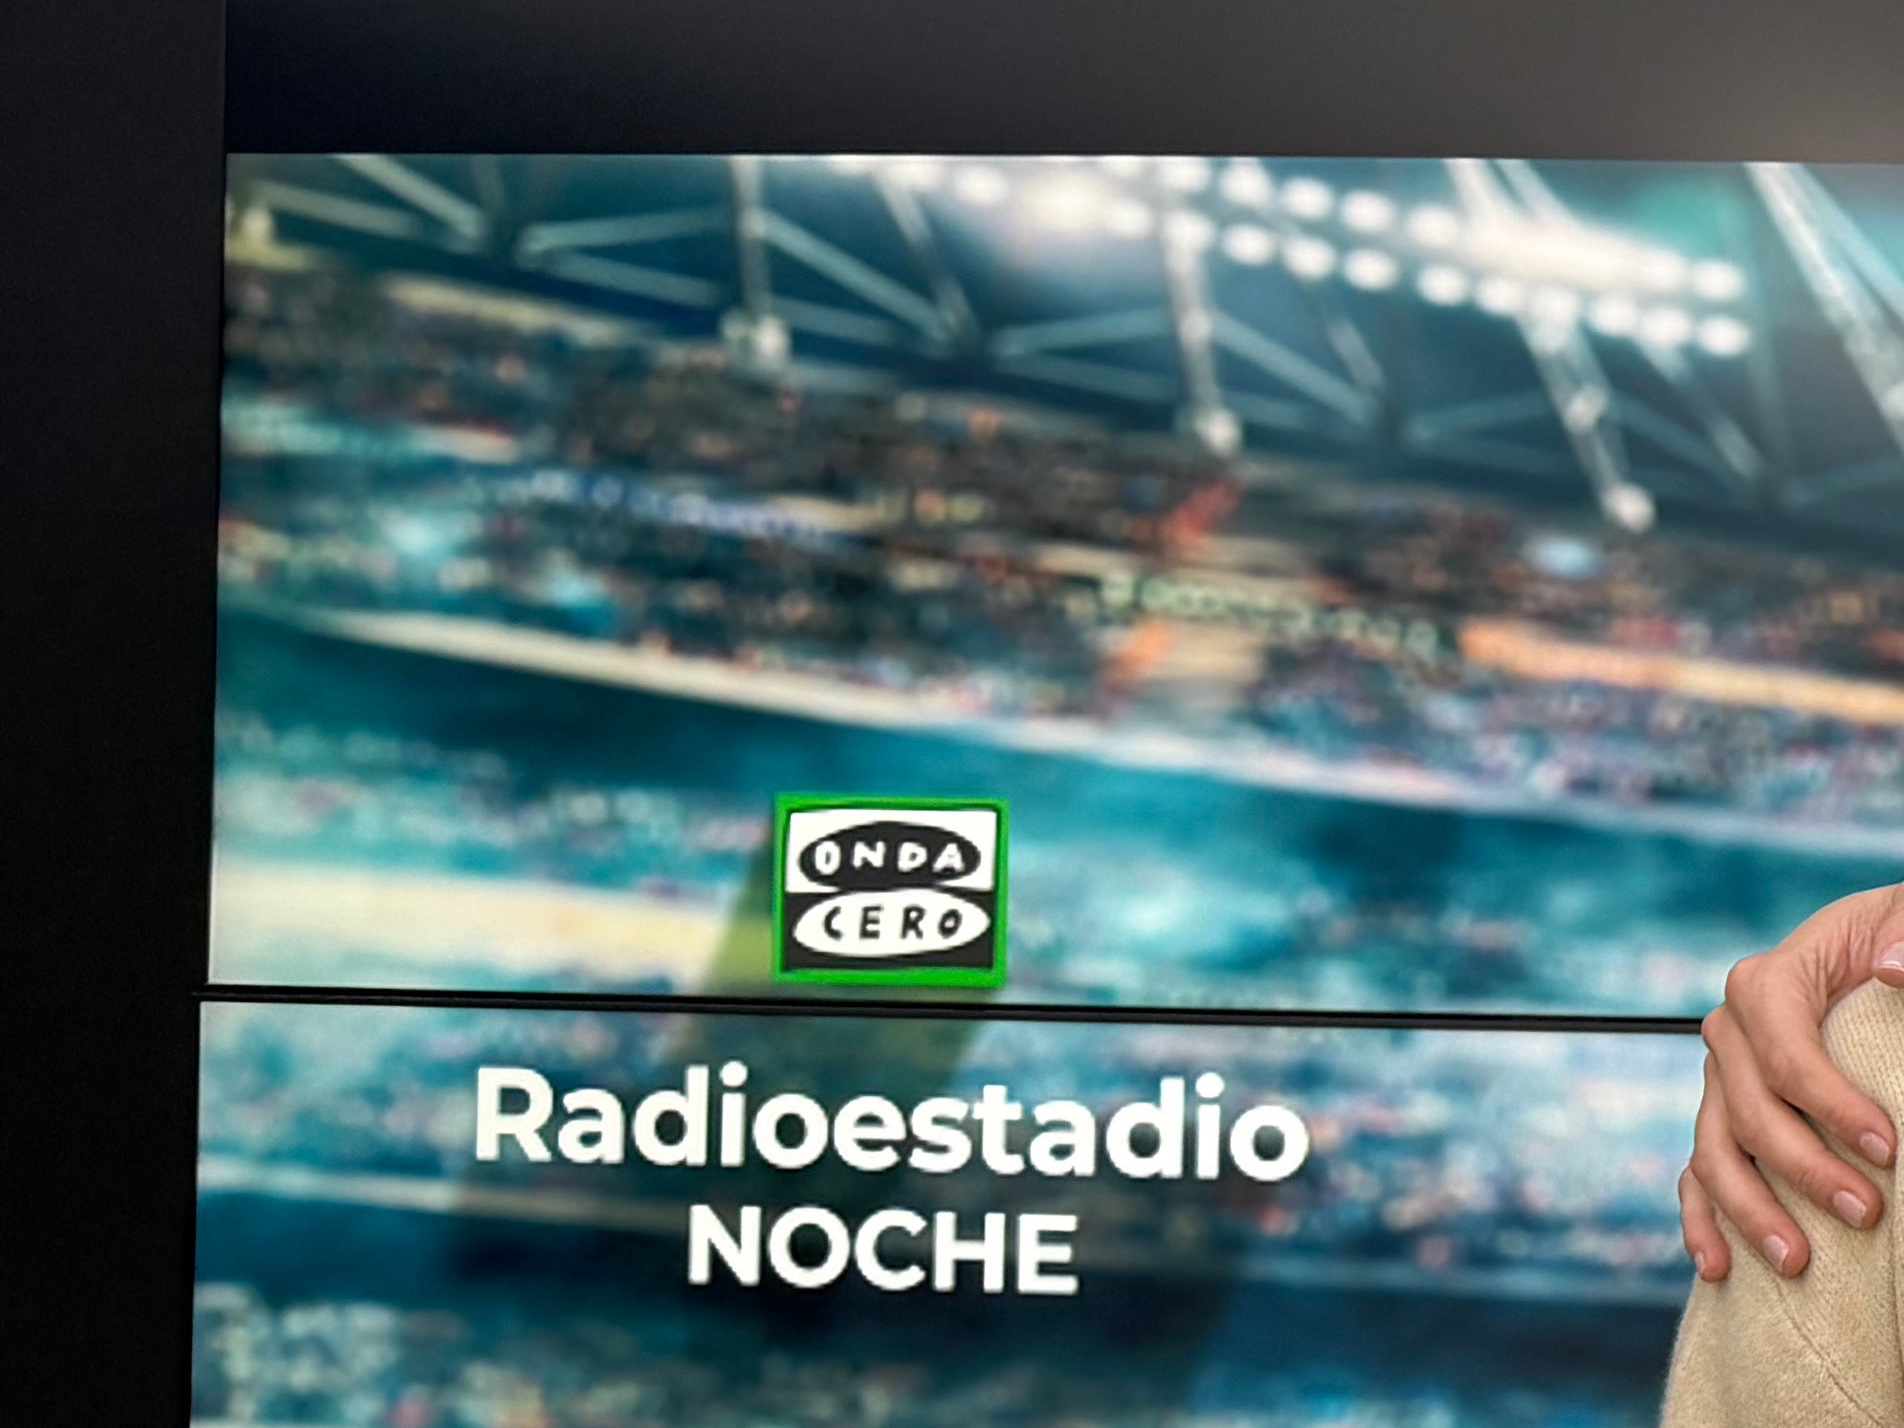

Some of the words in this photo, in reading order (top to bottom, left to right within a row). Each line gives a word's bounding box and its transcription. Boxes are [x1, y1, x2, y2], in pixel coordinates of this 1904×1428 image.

[813, 839, 966, 876] ONDA
[822, 903, 963, 941] CERO
[474, 1060, 1311, 1181] Radioestadio
[687, 1203, 1079, 1294] NOCHE
